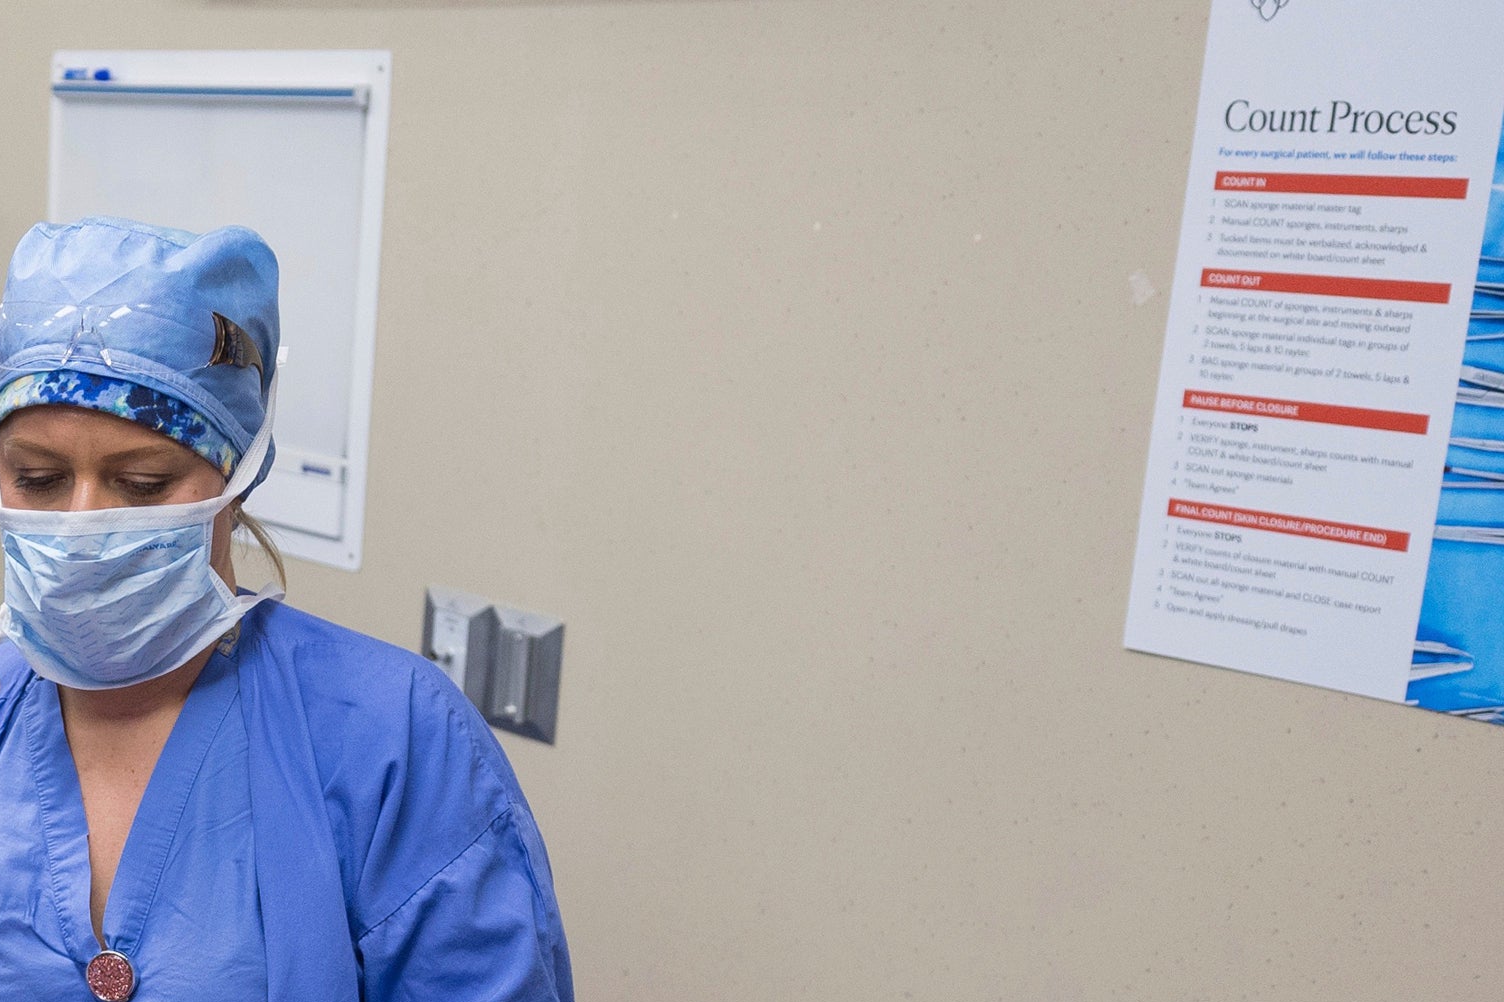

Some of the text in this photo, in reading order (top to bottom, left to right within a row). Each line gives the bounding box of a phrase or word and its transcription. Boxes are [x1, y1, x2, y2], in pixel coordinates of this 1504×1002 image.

[1224, 99, 1458, 136] Count Process
[1219, 147, 1232, 157] For
[1235, 149, 1258, 160] every
[1261, 148, 1295, 160] surgical
[1296, 150, 1331, 161] patient,
[1349, 151, 1365, 160] will
[1368, 151, 1396, 160] follow
[1399, 152, 1425, 161] these
[1428, 154, 1457, 164] steps:
[1222, 176, 1267, 187] COUNT IN
[1224, 198, 1248, 208] SCAN
[1250, 202, 1280, 210] sponge
[1282, 202, 1314, 211] material
[1348, 205, 1362, 215] tag
[1222, 216, 1250, 226] Manual
[1253, 218, 1284, 226] COUNT
[1380, 224, 1408, 234] sharps
[1274, 237, 1294, 246] must
[1355, 240, 1418, 254] acknowledged
[1420, 243, 1427, 253] &
[1282, 252, 1306, 260] white
[1308, 252, 1360, 264] board/count
[1362, 255, 1386, 264] sheet
[1208, 272, 1262, 286] COUNT OUT
[1210, 295, 1240, 306] Manual
[1241, 297, 1272, 308] COUNT
[1274, 301, 1284, 309] of
[1322, 304, 1372, 316] instruments
[1375, 308, 1382, 317] &
[1384, 309, 1413, 320] sharps
[1208, 310, 1246, 322] beginning
[1258, 313, 1270, 322] the
[1274, 316, 1304, 326] surgical
[1322, 319, 1339, 328] and
[1340, 321, 1372, 332] moving
[1374, 324, 1410, 334] outward
[1206, 325, 1230, 336] SCAN
[1232, 329, 1260, 340] sponge
[1262, 332, 1296, 342] material
[1297, 334, 1337, 345] individual
[1338, 338, 1356, 348] tags
[1368, 342, 1397, 352] groups
[1400, 342, 1410, 352] of
[1246, 343, 1264, 354] laps
[1264, 345, 1271, 354] &
[1274, 346, 1283, 354] 10
[1200, 369, 1208, 378] 10
[1220, 359, 1249, 370] sponge
[1251, 360, 1284, 372] material
[1294, 366, 1323, 376] groups
[1325, 368, 1334, 376] of
[1336, 368, 1342, 378] 2
[1383, 374, 1401, 384] laps
[1402, 375, 1410, 384] &
[1190, 394, 1299, 416] PAUSE BEFORE CLOSURE
[1192, 418, 1259, 432] Everyone STOPS
[1188, 446, 1328, 472] COUNT & white board/count sheet
[1191, 433, 1219, 442] VERIFY
[1300, 447, 1328, 458] sharps
[1330, 452, 1358, 462] counts
[1360, 456, 1380, 464] with
[1381, 458, 1414, 469] manual
[1186, 462, 1293, 484] SCAN out sponge materials
[1176, 504, 1388, 546] FINAL COUNT (SKIN CLOSURE/PROCEDURE END)
[1176, 525, 1242, 542] Everyone STOPS
[1172, 555, 1276, 578] & white board/count sheet
[1176, 542, 1394, 584] VERIFY counts of closure material with manual COUNT
[1172, 570, 1194, 582] SCAN
[1196, 576, 1208, 584] out
[1222, 580, 1250, 592] sponge
[1252, 584, 1284, 598] material
[1285, 591, 1302, 600] and
[1302, 592, 1330, 606] CLOSE
[1334, 600, 1354, 610] case
[1355, 604, 1382, 614] report
[1166, 602, 1308, 636] Open and apply dressing/pull drapes
